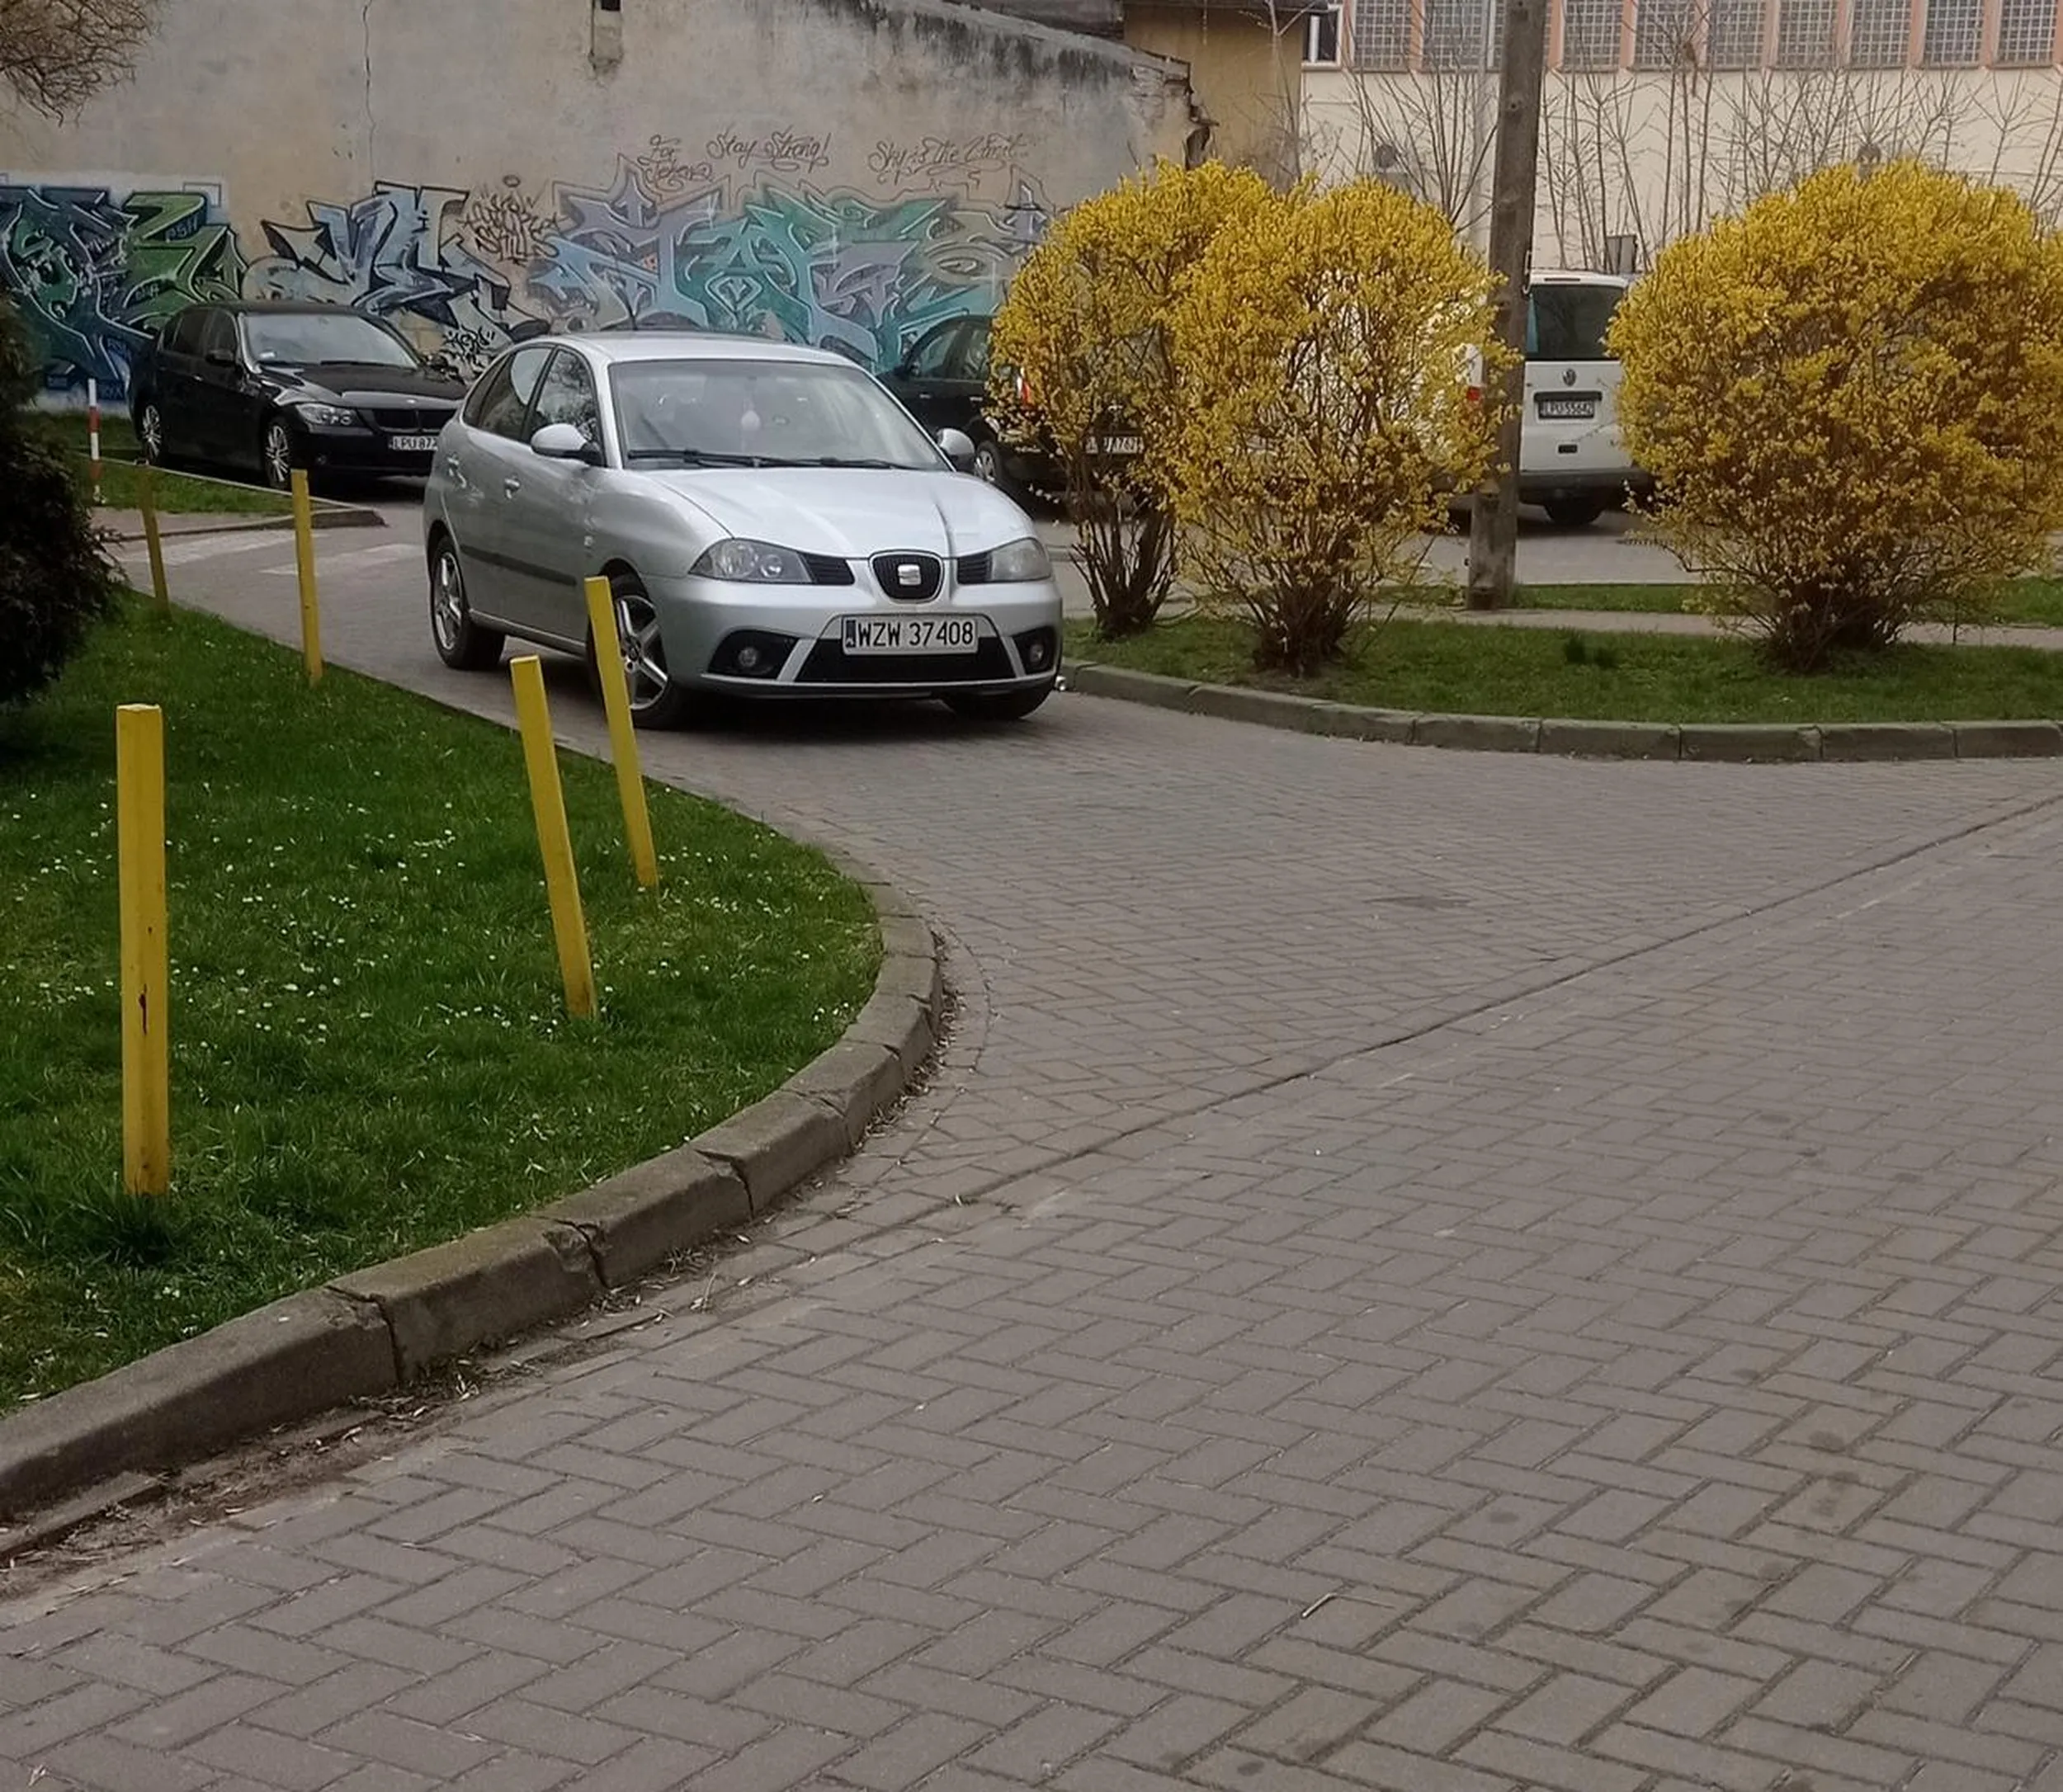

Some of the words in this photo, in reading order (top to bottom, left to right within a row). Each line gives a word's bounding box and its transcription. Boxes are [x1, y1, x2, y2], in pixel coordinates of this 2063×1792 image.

[706, 124, 758, 169] Stay
[858, 622, 901, 646] WZW
[909, 621, 974, 646] 37408
